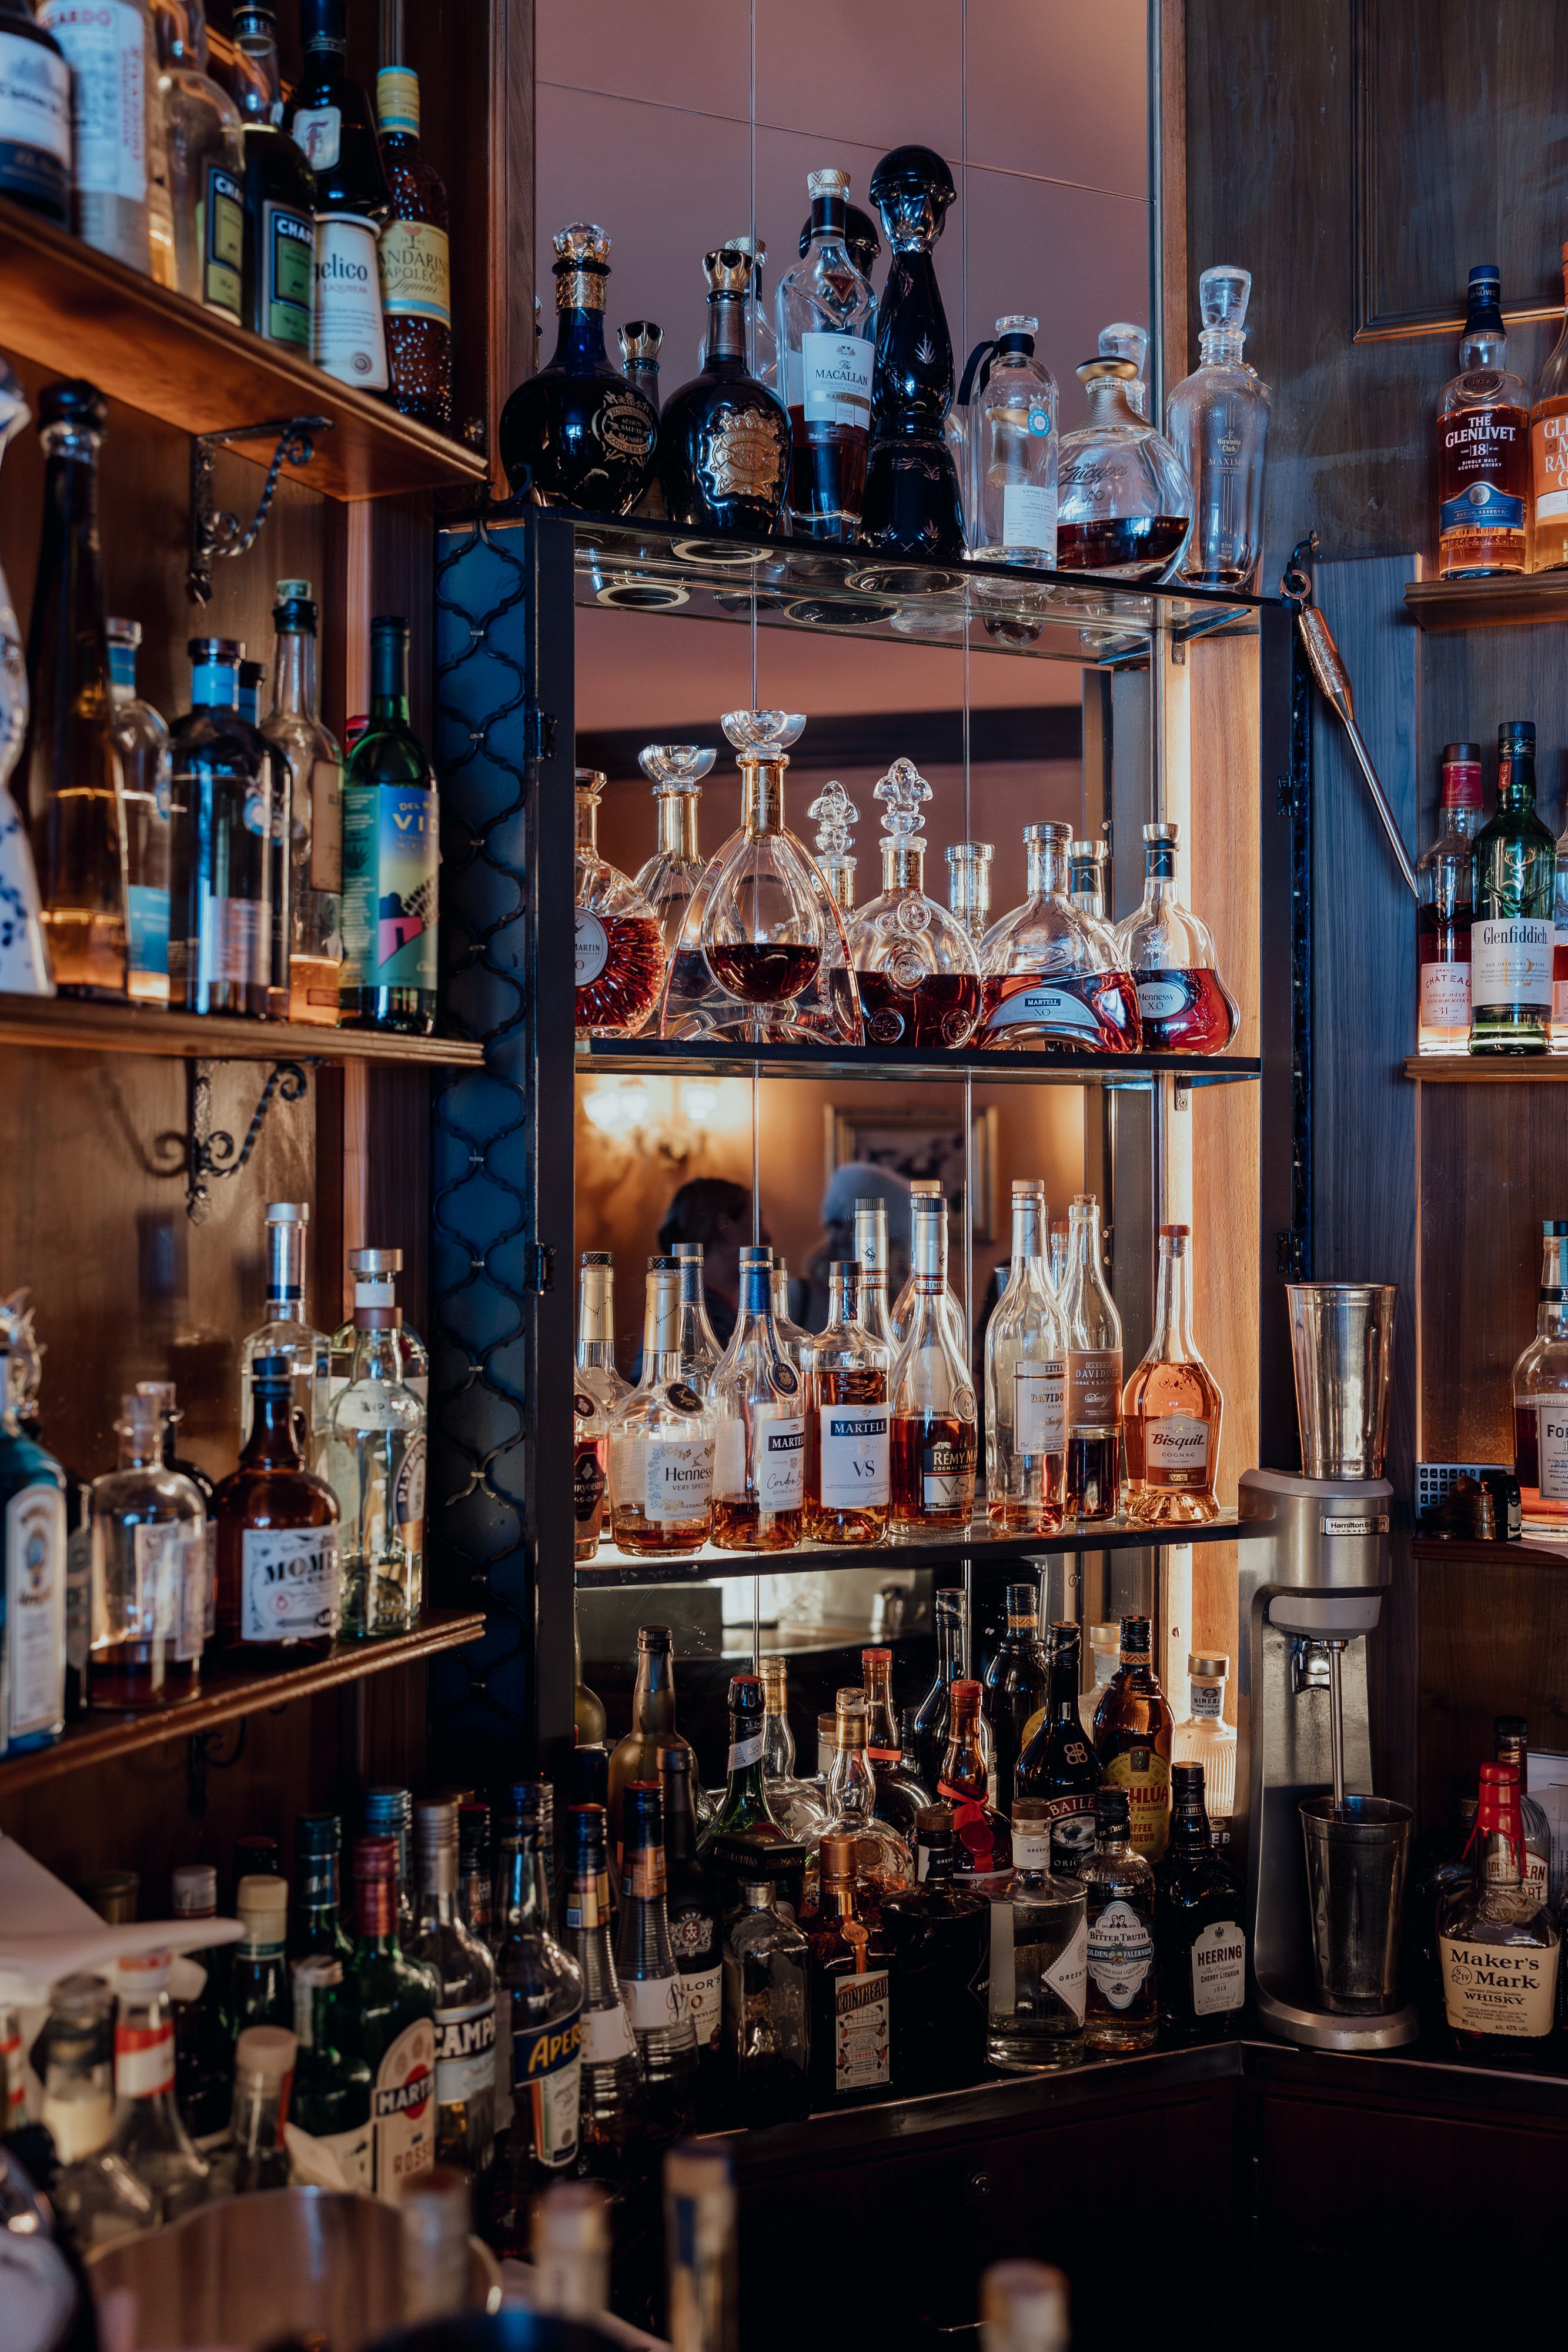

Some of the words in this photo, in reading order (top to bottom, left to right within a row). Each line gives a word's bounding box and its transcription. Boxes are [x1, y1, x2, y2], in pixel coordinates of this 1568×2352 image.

[837, 360, 851, 370] The
[815, 370, 868, 386] MACALLAN
[1468, 416, 1491, 427] THE
[621, 425, 642, 435] SALUTE
[607, 435, 630, 451] SCOTCH
[618, 433, 643, 443] BLENDED
[1218, 437, 1241, 446] Havana
[1472, 444, 1486, 456] 18
[1209, 456, 1248, 466] MÁXIMO
[1058, 466, 1128, 489] Zacapa
[1083, 490, 1105, 502] XO
[1484, 926, 1547, 945] Glenfiddich
[1499, 957, 1533, 987] 12
[1426, 973, 1471, 988] CHÂTEAU
[1138, 993, 1174, 1002] Hennessy
[1075, 1369, 1118, 1378] DAVIDOFF
[1031, 1392, 1064, 1403] DAVIDO
[835, 1422, 885, 1433] MARTELL
[1151, 1433, 1205, 1451] Bisquit
[934, 1451, 965, 1465] RÉMY
[967, 1449, 978, 1463] MA
[851, 1460, 875, 1477] VS
[767, 1472, 797, 1489] Cordon
[1090, 1931, 1119, 1942] BITTER
[1120, 1932, 1146, 1942] TRUTH
[1124, 1947, 1152, 1957] FALERNUM
[1198, 1945, 1242, 1967] HEERING
[1450, 1948, 1539, 1970] Maker's
[1096, 1963, 1111, 1973] SPICED
[1124, 1963, 1141, 1975] LIQUEUR
[1215, 1962, 1236, 1973] Original
[1201, 1974, 1219, 1983] CHERRY
[1220, 1970, 1239, 1979] LIQUEUR
[1475, 1970, 1540, 1989] Mark
[837, 1978, 888, 2013] COINTREAU
[1464, 1992, 1526, 2004] WHISKY
